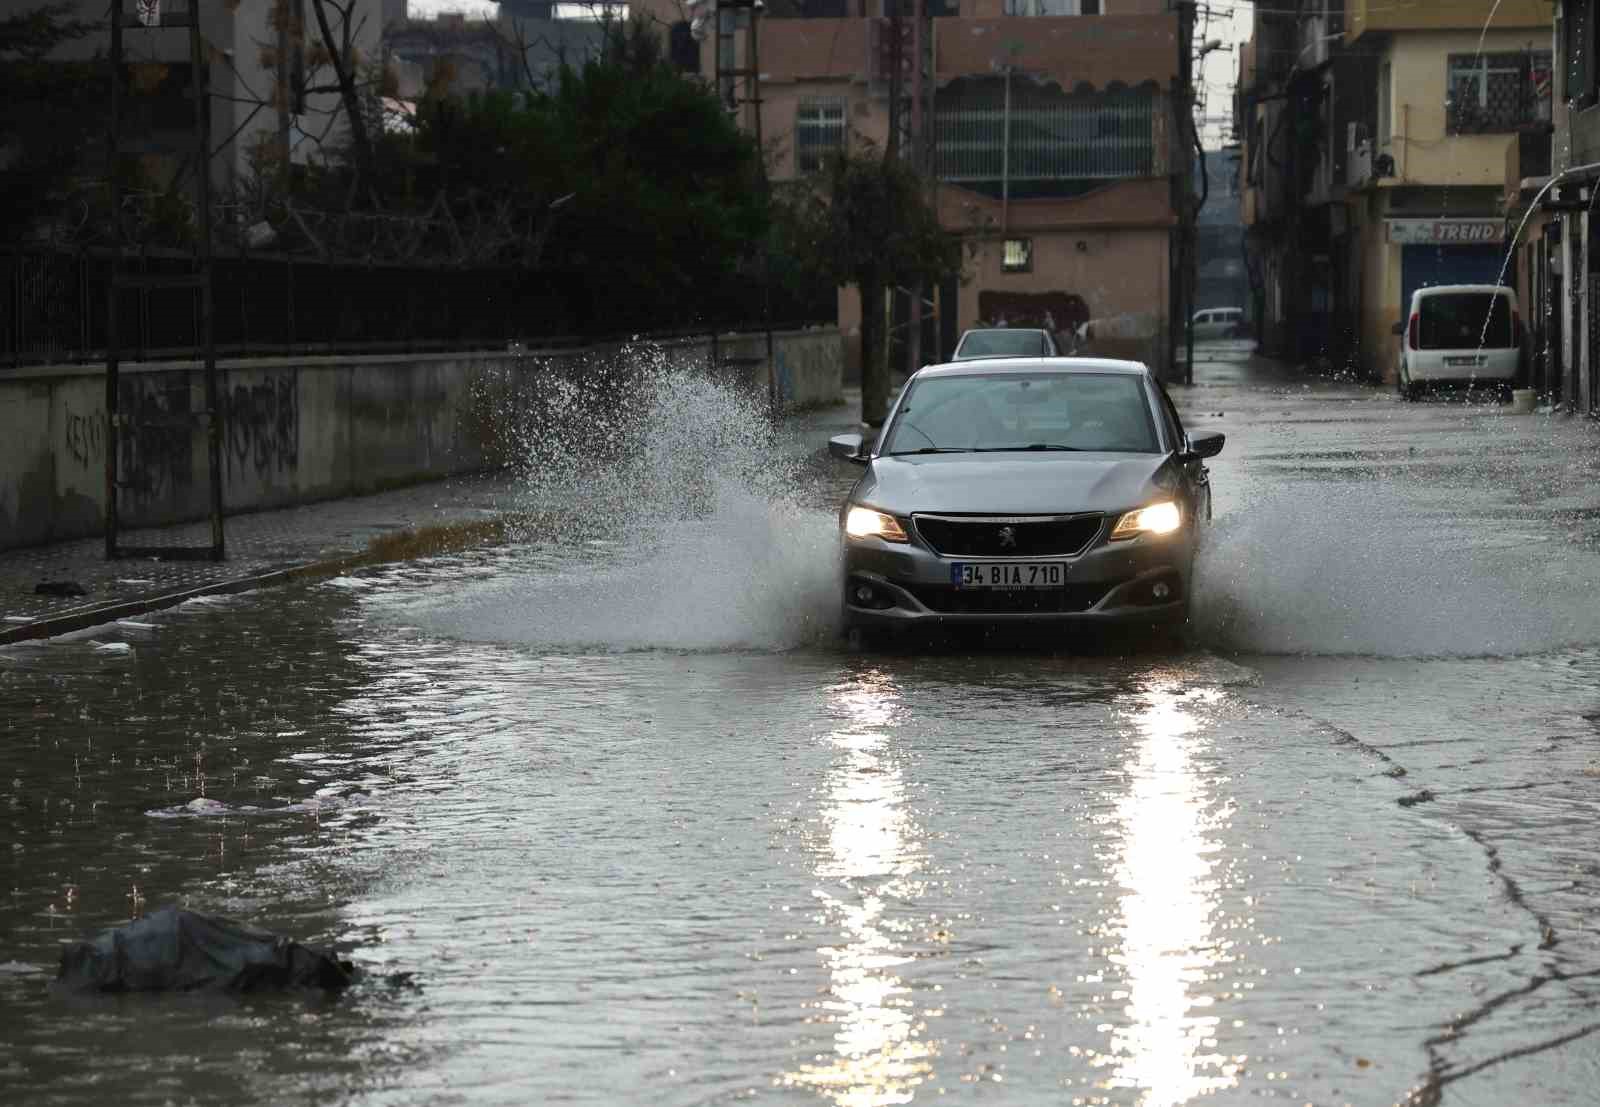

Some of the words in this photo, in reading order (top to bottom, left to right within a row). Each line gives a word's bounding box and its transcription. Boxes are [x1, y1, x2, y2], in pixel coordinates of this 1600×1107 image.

[1439, 224, 1495, 241] TREND
[964, 566, 984, 584] 34
[991, 566, 1022, 584] BIA
[1028, 565, 1060, 584] 710
